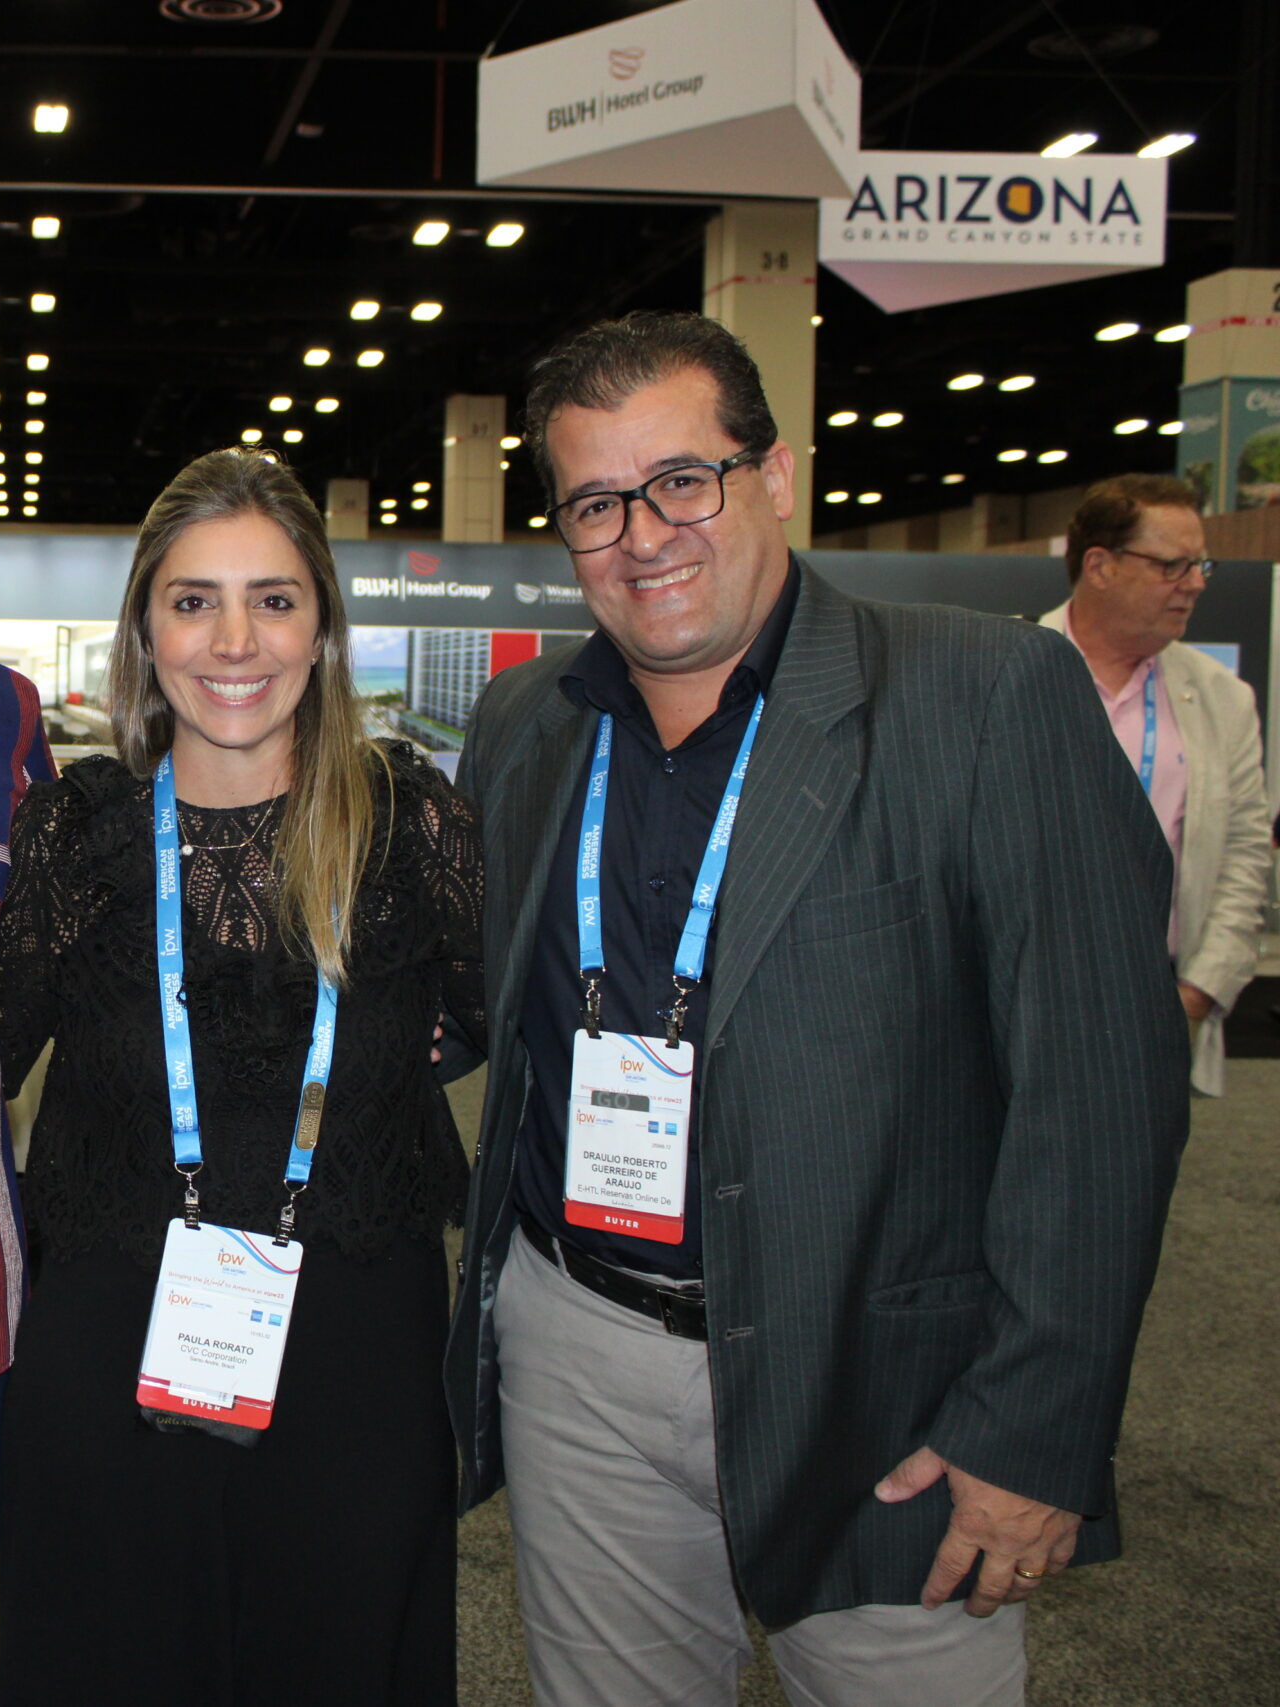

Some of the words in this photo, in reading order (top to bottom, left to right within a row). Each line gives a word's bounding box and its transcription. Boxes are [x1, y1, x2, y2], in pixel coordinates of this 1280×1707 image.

[546, 97, 596, 133] BWH
[606, 85, 649, 114] Hotel
[652, 74, 704, 99] Group
[845, 174, 1141, 225] ARIZONA
[842, 228, 930, 242] GRAND
[947, 228, 1051, 243] CANYON
[1070, 231, 1143, 246] STATE
[351, 576, 399, 597] BWH
[407, 581, 446, 596] Hotel
[446, 582, 492, 600] Group
[592, 770, 608, 797] ipw
[157, 808, 175, 834] ipw
[710, 795, 735, 852] AMERICAN
[581, 831, 593, 880] EXPRESS
[589, 824, 601, 879] AMERICAN
[160, 849, 169, 900] AMERICAN
[167, 847, 176, 893] EXPRESS
[581, 896, 600, 926] ipw
[160, 928, 180, 957] ipw
[163, 973, 177, 1030] AMERICAN
[310, 1025, 325, 1077] EXPRESS
[317, 1020, 332, 1078] AMERICAN
[172, 1060, 192, 1090] ipw
[620, 1055, 644, 1073] ipw
[576, 1109, 596, 1125] ipw
[583, 1150, 621, 1164] DRAULIO
[623, 1156, 667, 1170] ROBERTO
[591, 1163, 643, 1179] GUERREIRO
[645, 1171, 658, 1180] DE
[577, 1184, 599, 1195] E-HTL
[600, 1187, 633, 1200] Reservas
[635, 1193, 659, 1203] Online
[660, 1196, 672, 1206] De
[605, 1177, 642, 1190] ARAUJO
[605, 1215, 639, 1229] BUYER
[217, 1248, 245, 1266] ipw
[168, 1289, 192, 1305] ipw
[178, 1332, 211, 1347] PAULA
[213, 1340, 254, 1355] RORATO
[180, 1344, 199, 1356] CVC
[201, 1348, 248, 1365] Corporation
[182, 1398, 221, 1411] BUYER
